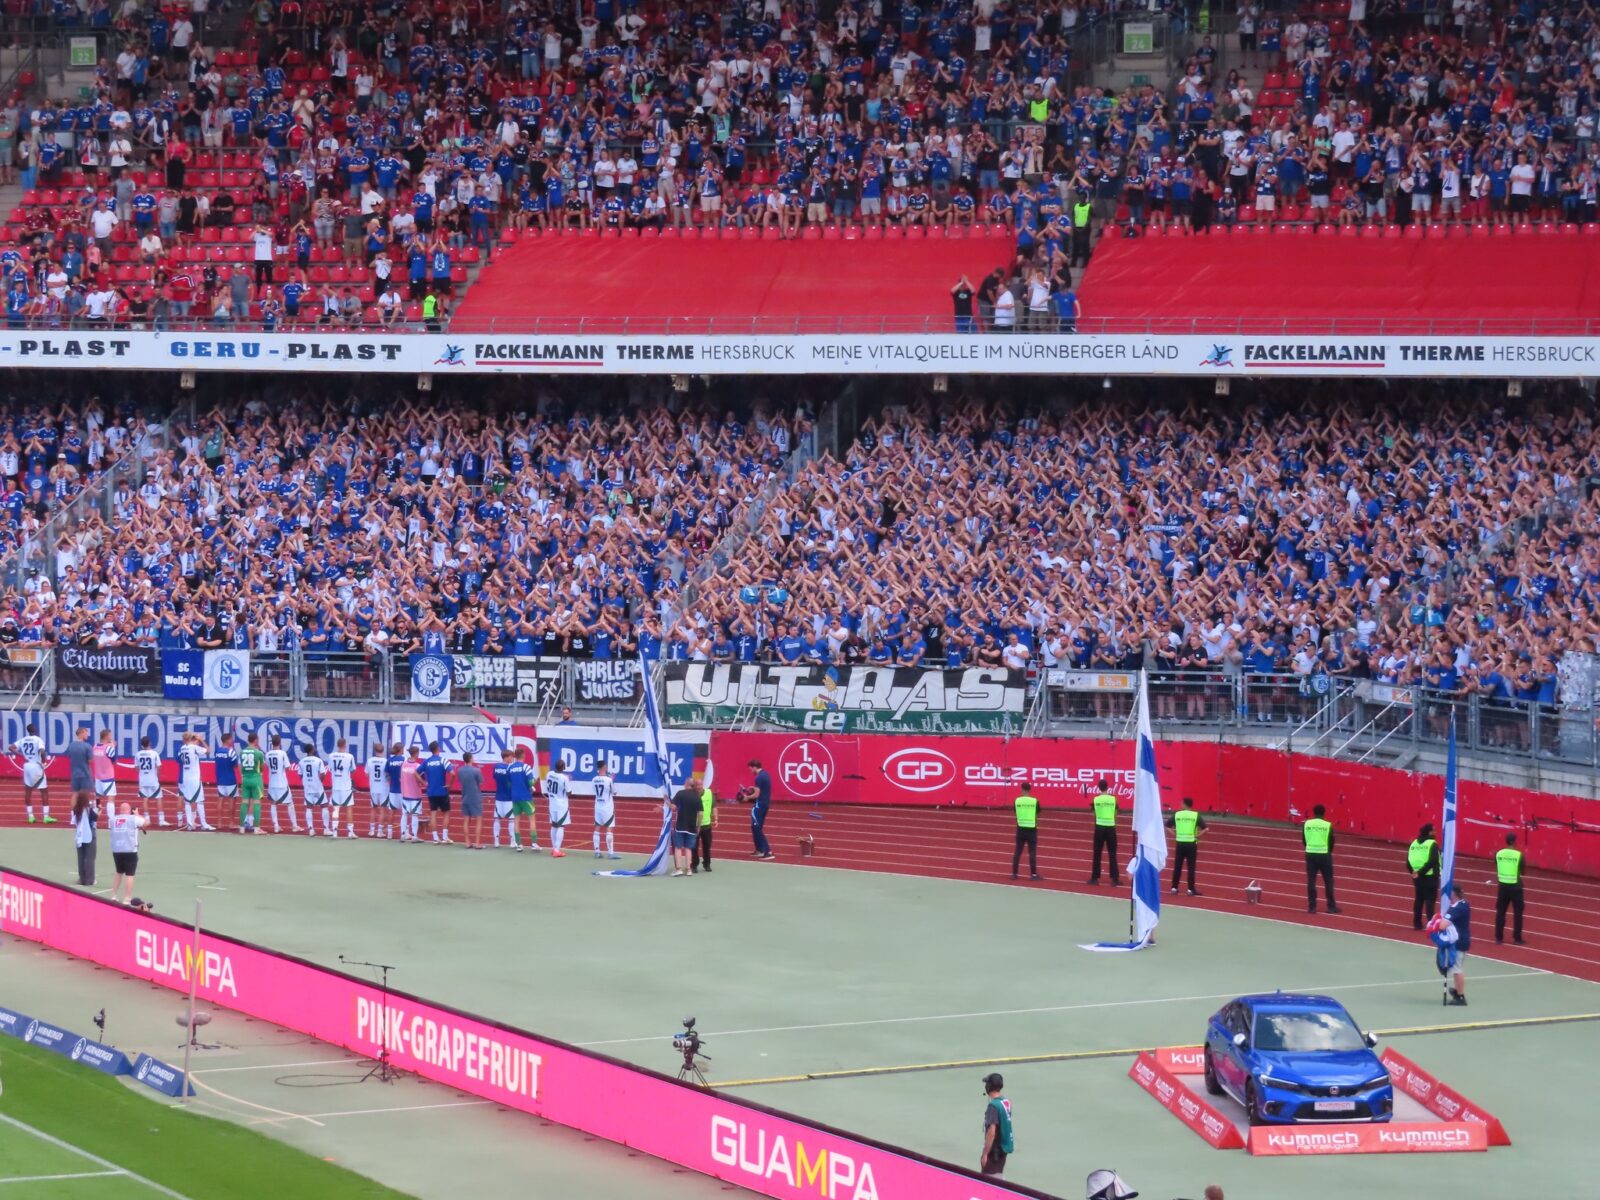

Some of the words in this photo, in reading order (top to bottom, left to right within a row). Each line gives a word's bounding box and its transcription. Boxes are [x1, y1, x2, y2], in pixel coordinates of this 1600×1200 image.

[475, 344, 603, 360] FACKELMANN
[616, 344, 694, 360] THERME
[701, 345, 795, 360] HERSBRUCK
[812, 345, 862, 359] MEINE
[868, 344, 979, 362] VITALQUELLE
[984, 345, 1001, 359] IM
[1008, 341, 1126, 360] NÜRNBERGER
[1244, 345, 1386, 361] FACKELMANN
[1400, 345, 1485, 361] THERME
[1492, 346, 1596, 362] HERSBRUCK
[62, 648, 149, 673] Eilenburg
[177, 662, 190, 673] SC
[473, 657, 516, 672] BLUE
[575, 660, 639, 682] MARLER
[190, 677, 202, 686] 04
[474, 672, 515, 687] BOYZ
[581, 681, 635, 699] JUNGS
[23, 743, 35, 755] 22
[294, 718, 390, 764] SOHN
[139, 757, 152, 770] 23
[241, 753, 255, 767] 28
[268, 757, 278, 770] 19
[332, 760, 344, 772] 14
[560, 746, 684, 778] Delbrük
[305, 764, 313, 777] 9
[374, 765, 381, 778] 5
[784, 762, 828, 784] FCN
[897, 761, 942, 780] GP
[964, 762, 1027, 780] GÖLZ
[1031, 769, 1136, 784] PALETTE
[594, 784, 605, 797] 17
[1079, 783, 1117, 795] Natual
[135, 928, 238, 998] GUAMPA
[357, 996, 542, 1099] PINK-GRAPEFRUIT
[1269, 1131, 1359, 1147] kummich
[1379, 1128, 1470, 1144] kummich
[711, 1114, 879, 1200] GUAMPA
